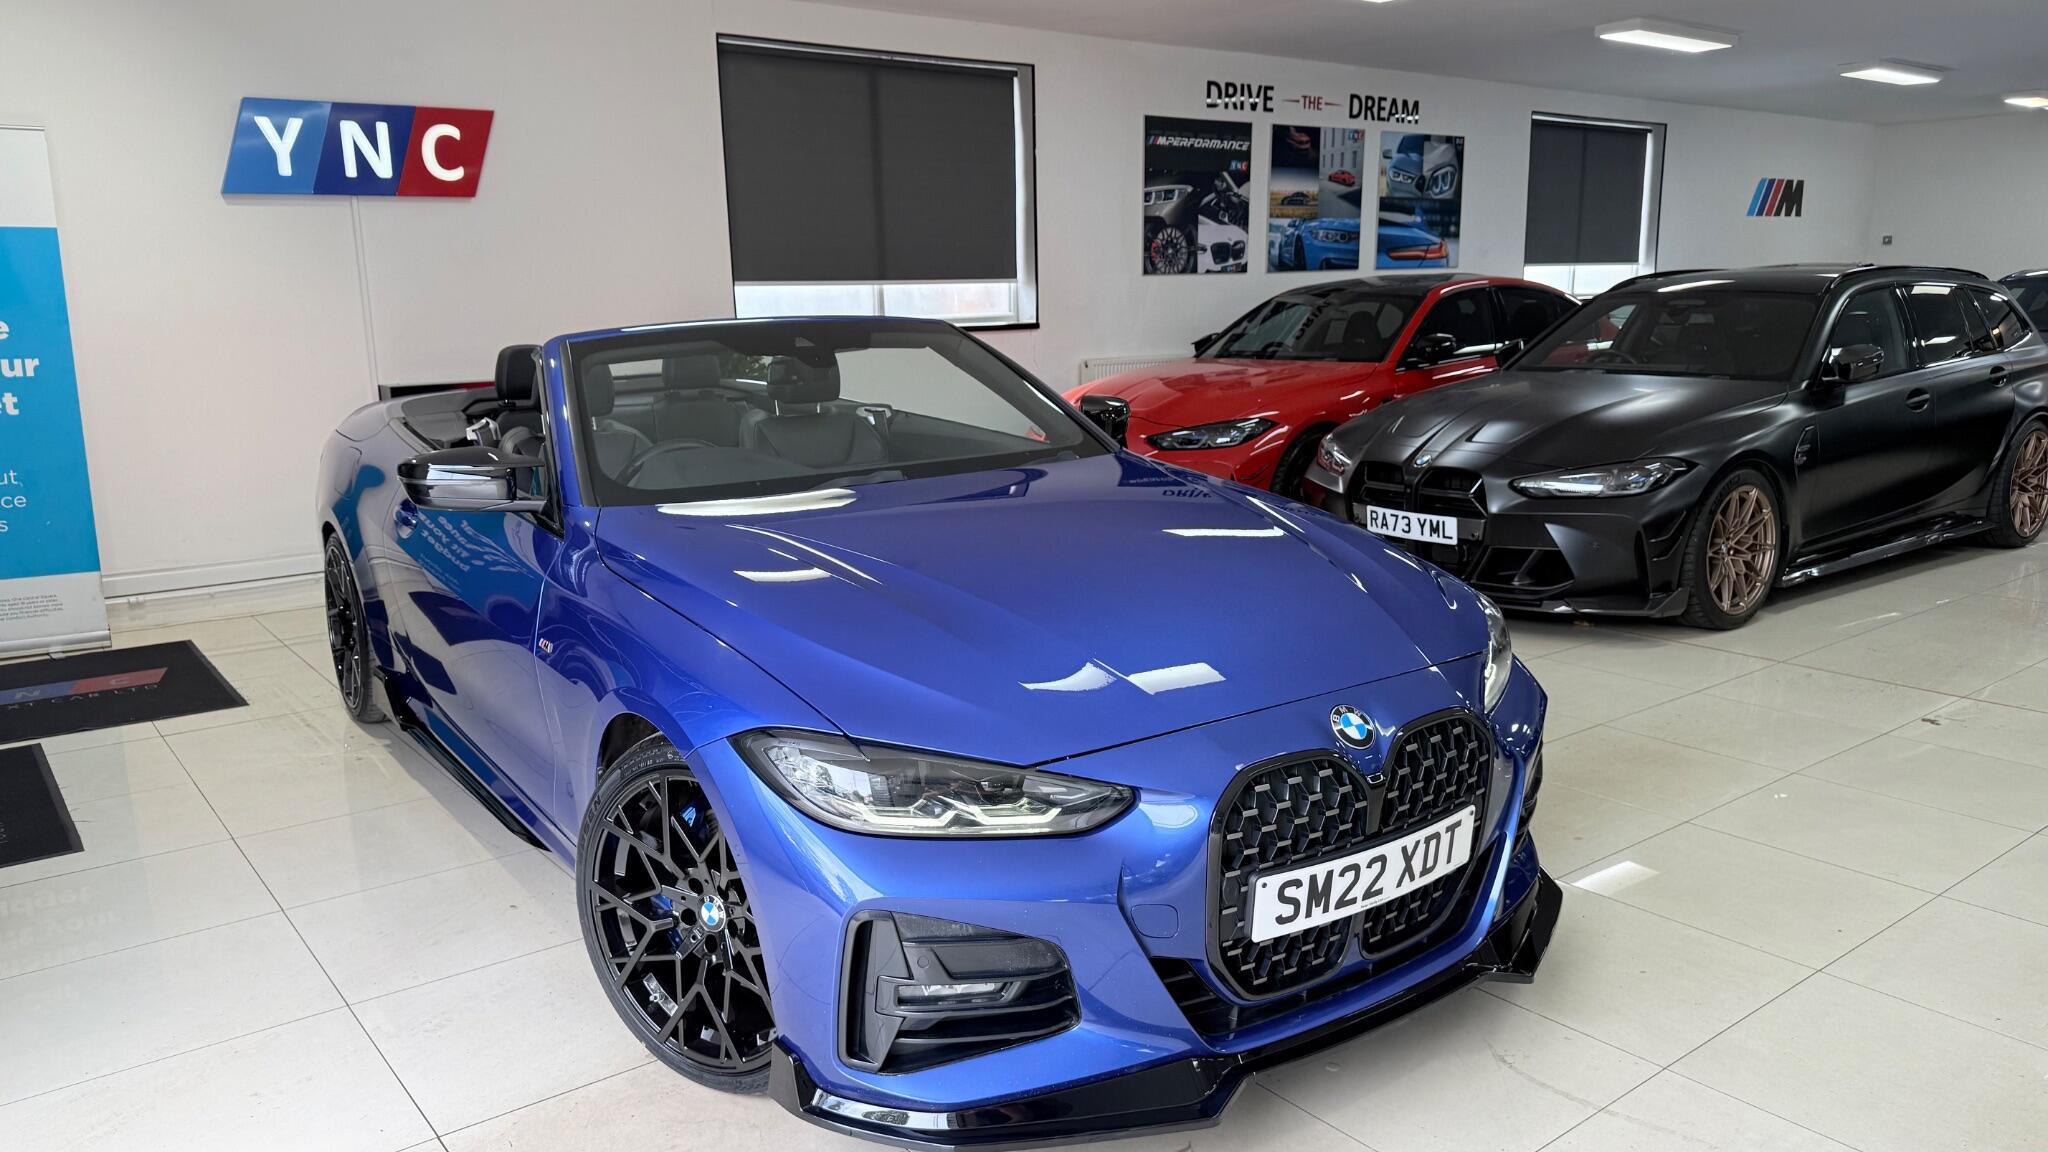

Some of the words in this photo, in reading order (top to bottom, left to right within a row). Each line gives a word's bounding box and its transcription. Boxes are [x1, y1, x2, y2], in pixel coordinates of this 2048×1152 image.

[1206, 80, 1274, 113] DRIVE
[1301, 95, 1323, 111] THE
[1349, 93, 1419, 124] DREAM
[255, 116, 465, 181] YNC
[0, 357, 40, 378] ur
[0, 495, 27, 509] ce
[1370, 509, 1411, 534] RA73
[1417, 517, 1453, 540] YML
[1275, 853, 1388, 925] SM22
[1396, 819, 1463, 889] XDT
